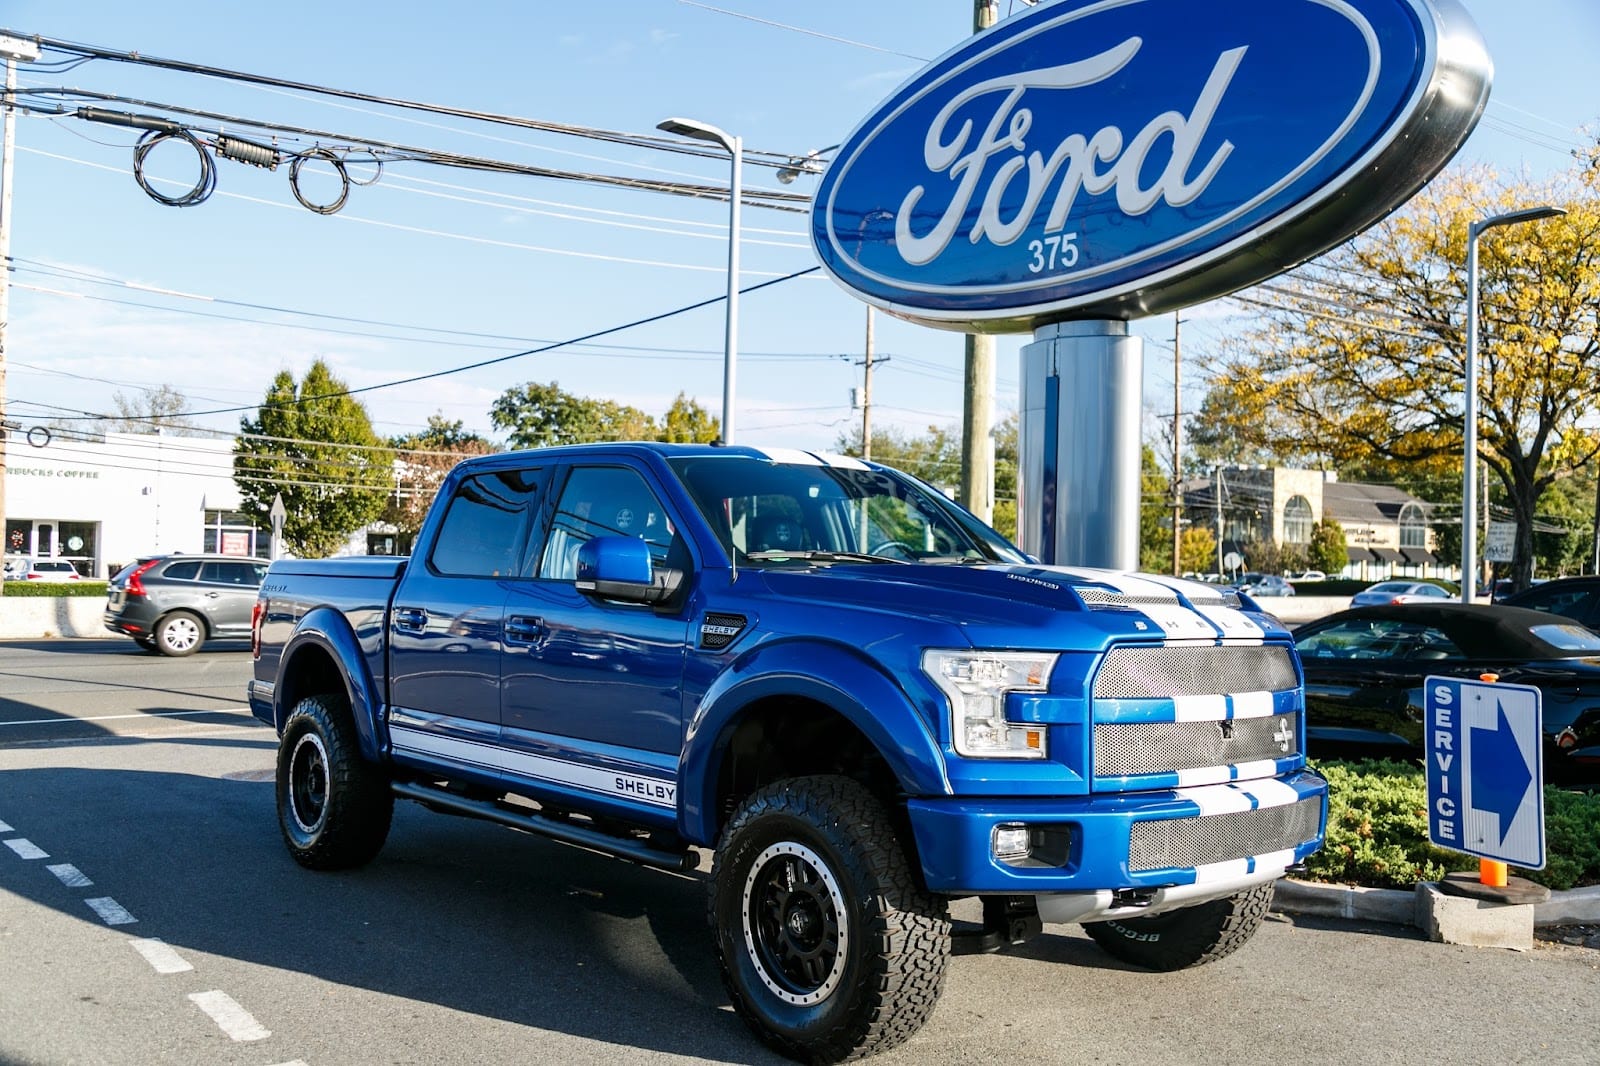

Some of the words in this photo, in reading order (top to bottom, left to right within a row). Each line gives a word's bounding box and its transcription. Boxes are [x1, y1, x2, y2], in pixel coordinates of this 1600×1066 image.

[895, 36, 1250, 266] Ford
[1027, 231, 1079, 274] 375
[56, 469, 99, 479] COFFEE
[703, 624, 735, 634] SHELBY
[1434, 685, 1456, 841] SERVICE
[615, 777, 676, 801] SHELBY
